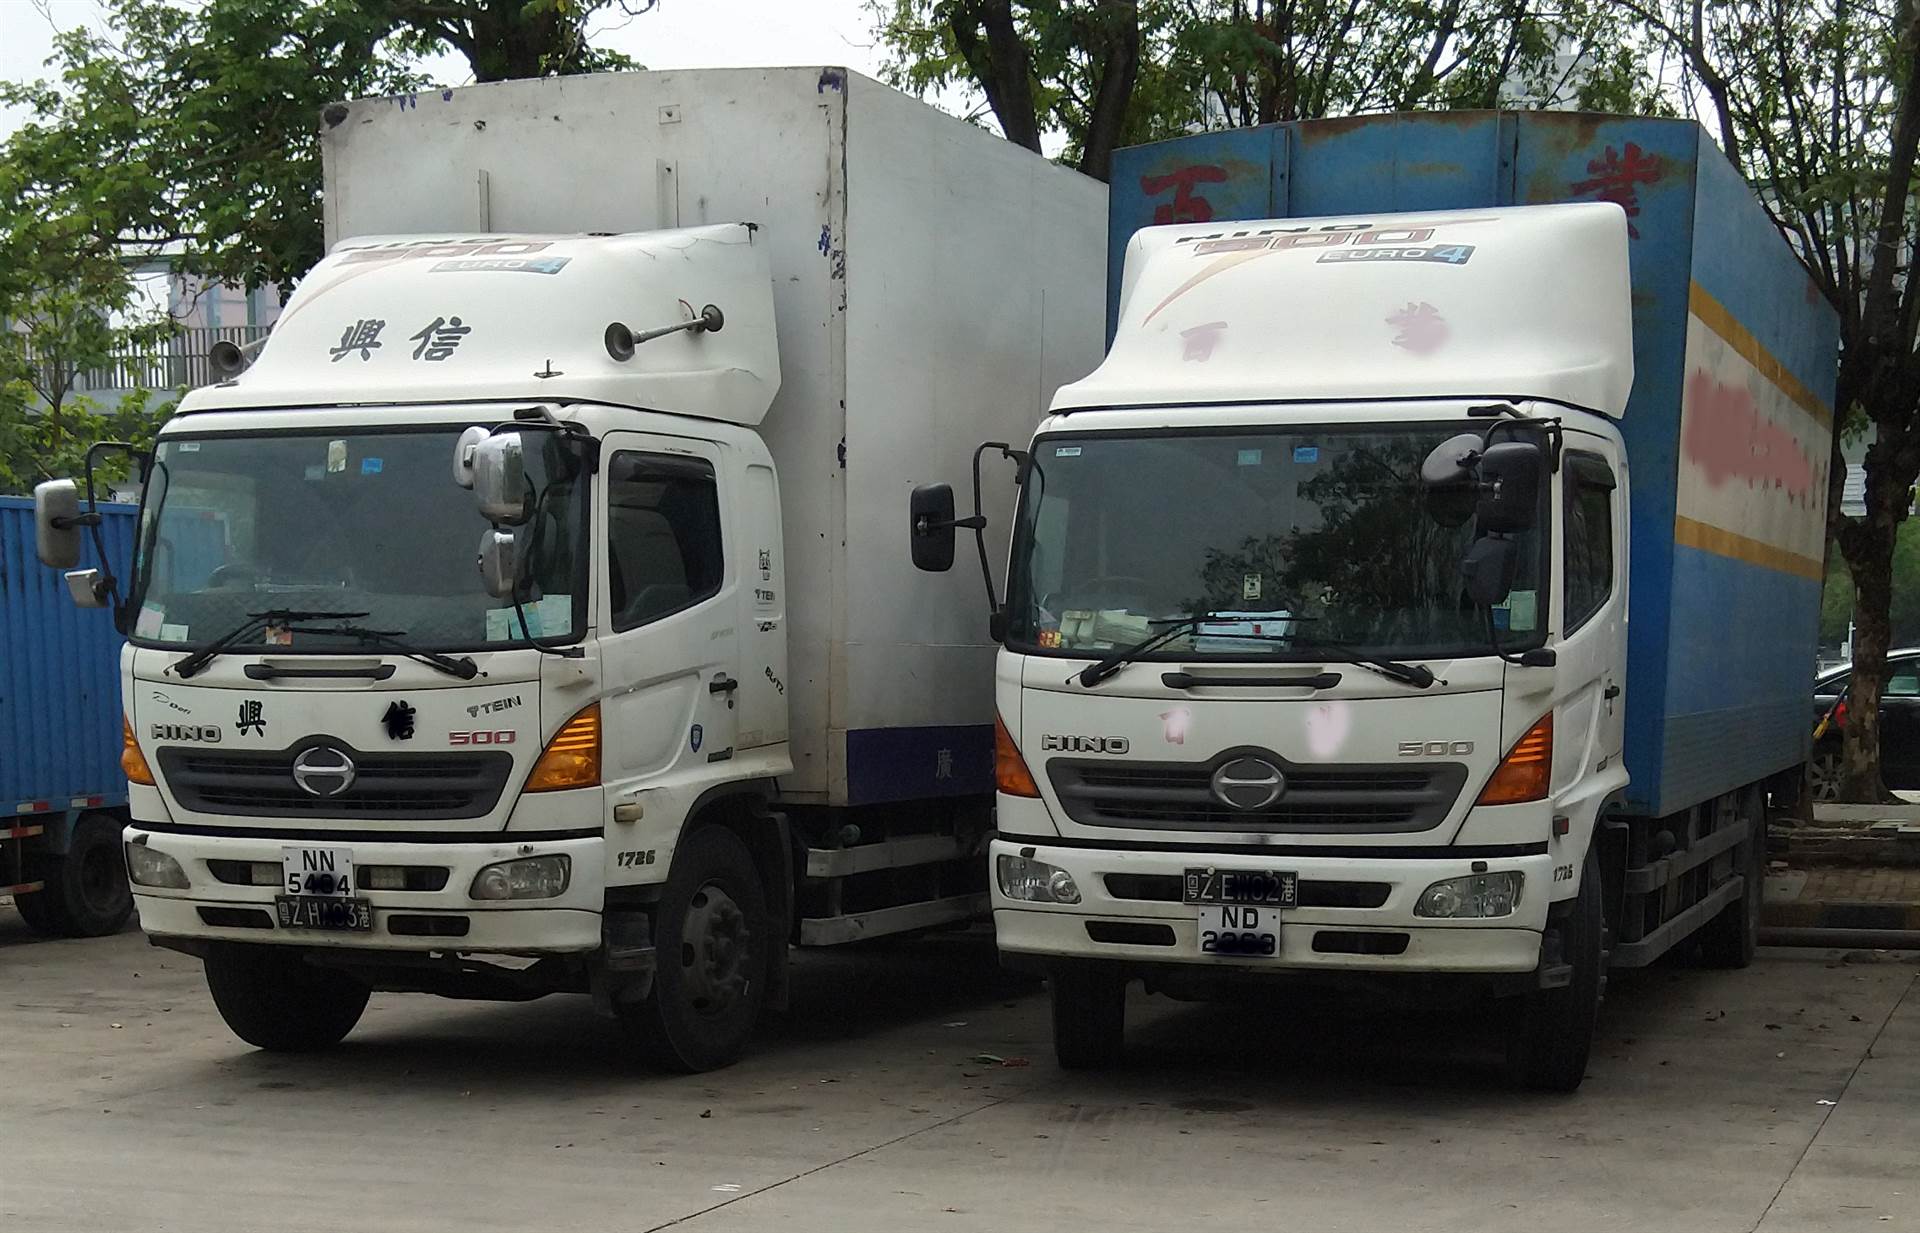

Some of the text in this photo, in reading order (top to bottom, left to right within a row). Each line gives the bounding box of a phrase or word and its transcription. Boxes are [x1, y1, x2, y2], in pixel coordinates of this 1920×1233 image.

[1193, 228, 1436, 257] 500
[481, 695, 523, 715] TEIN
[151, 723, 222, 743] HINO
[449, 730, 517, 745] 500
[1041, 734, 1130, 754] HINO
[1398, 740, 1475, 757] 500
[302, 850, 335, 871] NN
[1221, 906, 1259, 929] ND
